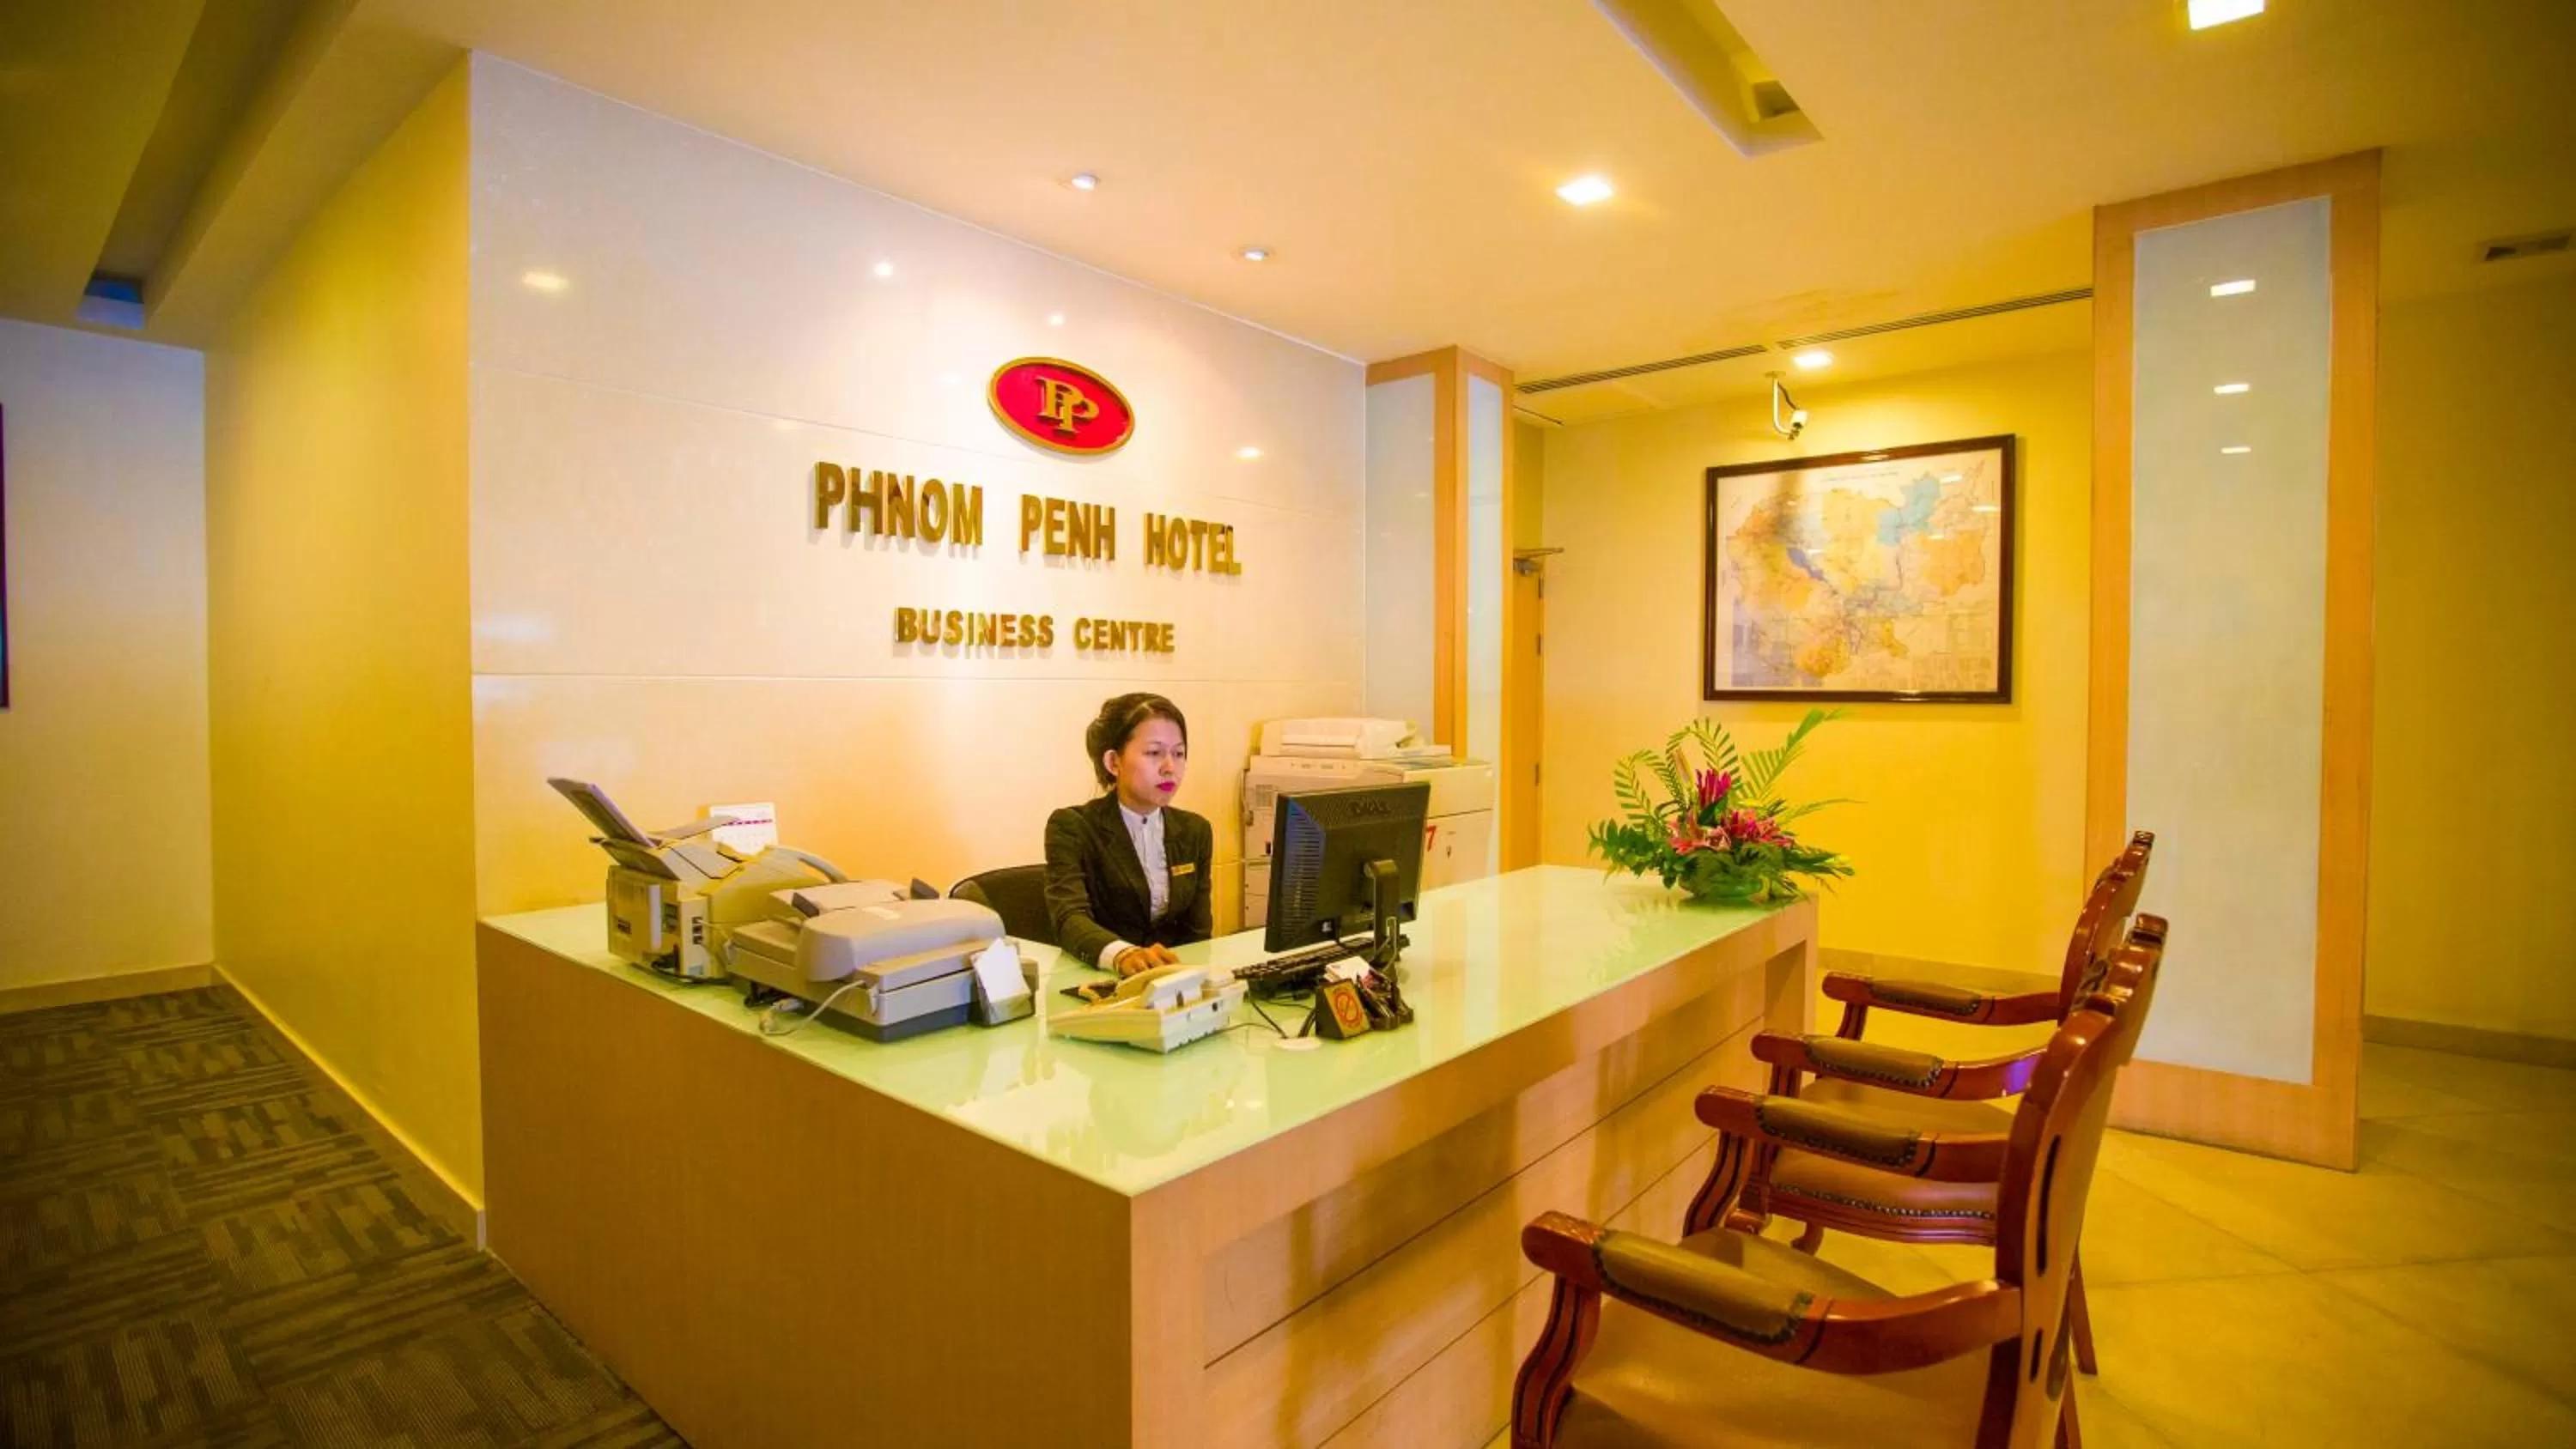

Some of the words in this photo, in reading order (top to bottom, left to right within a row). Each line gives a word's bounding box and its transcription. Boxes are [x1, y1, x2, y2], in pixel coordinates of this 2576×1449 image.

[814, 461, 984, 547] PHNOM
[1019, 494, 1116, 561] PENH
[1143, 512, 1242, 575] HOTEL
[895, 606, 1054, 648] BUSINESS
[1072, 616, 1176, 653] CENTRE
